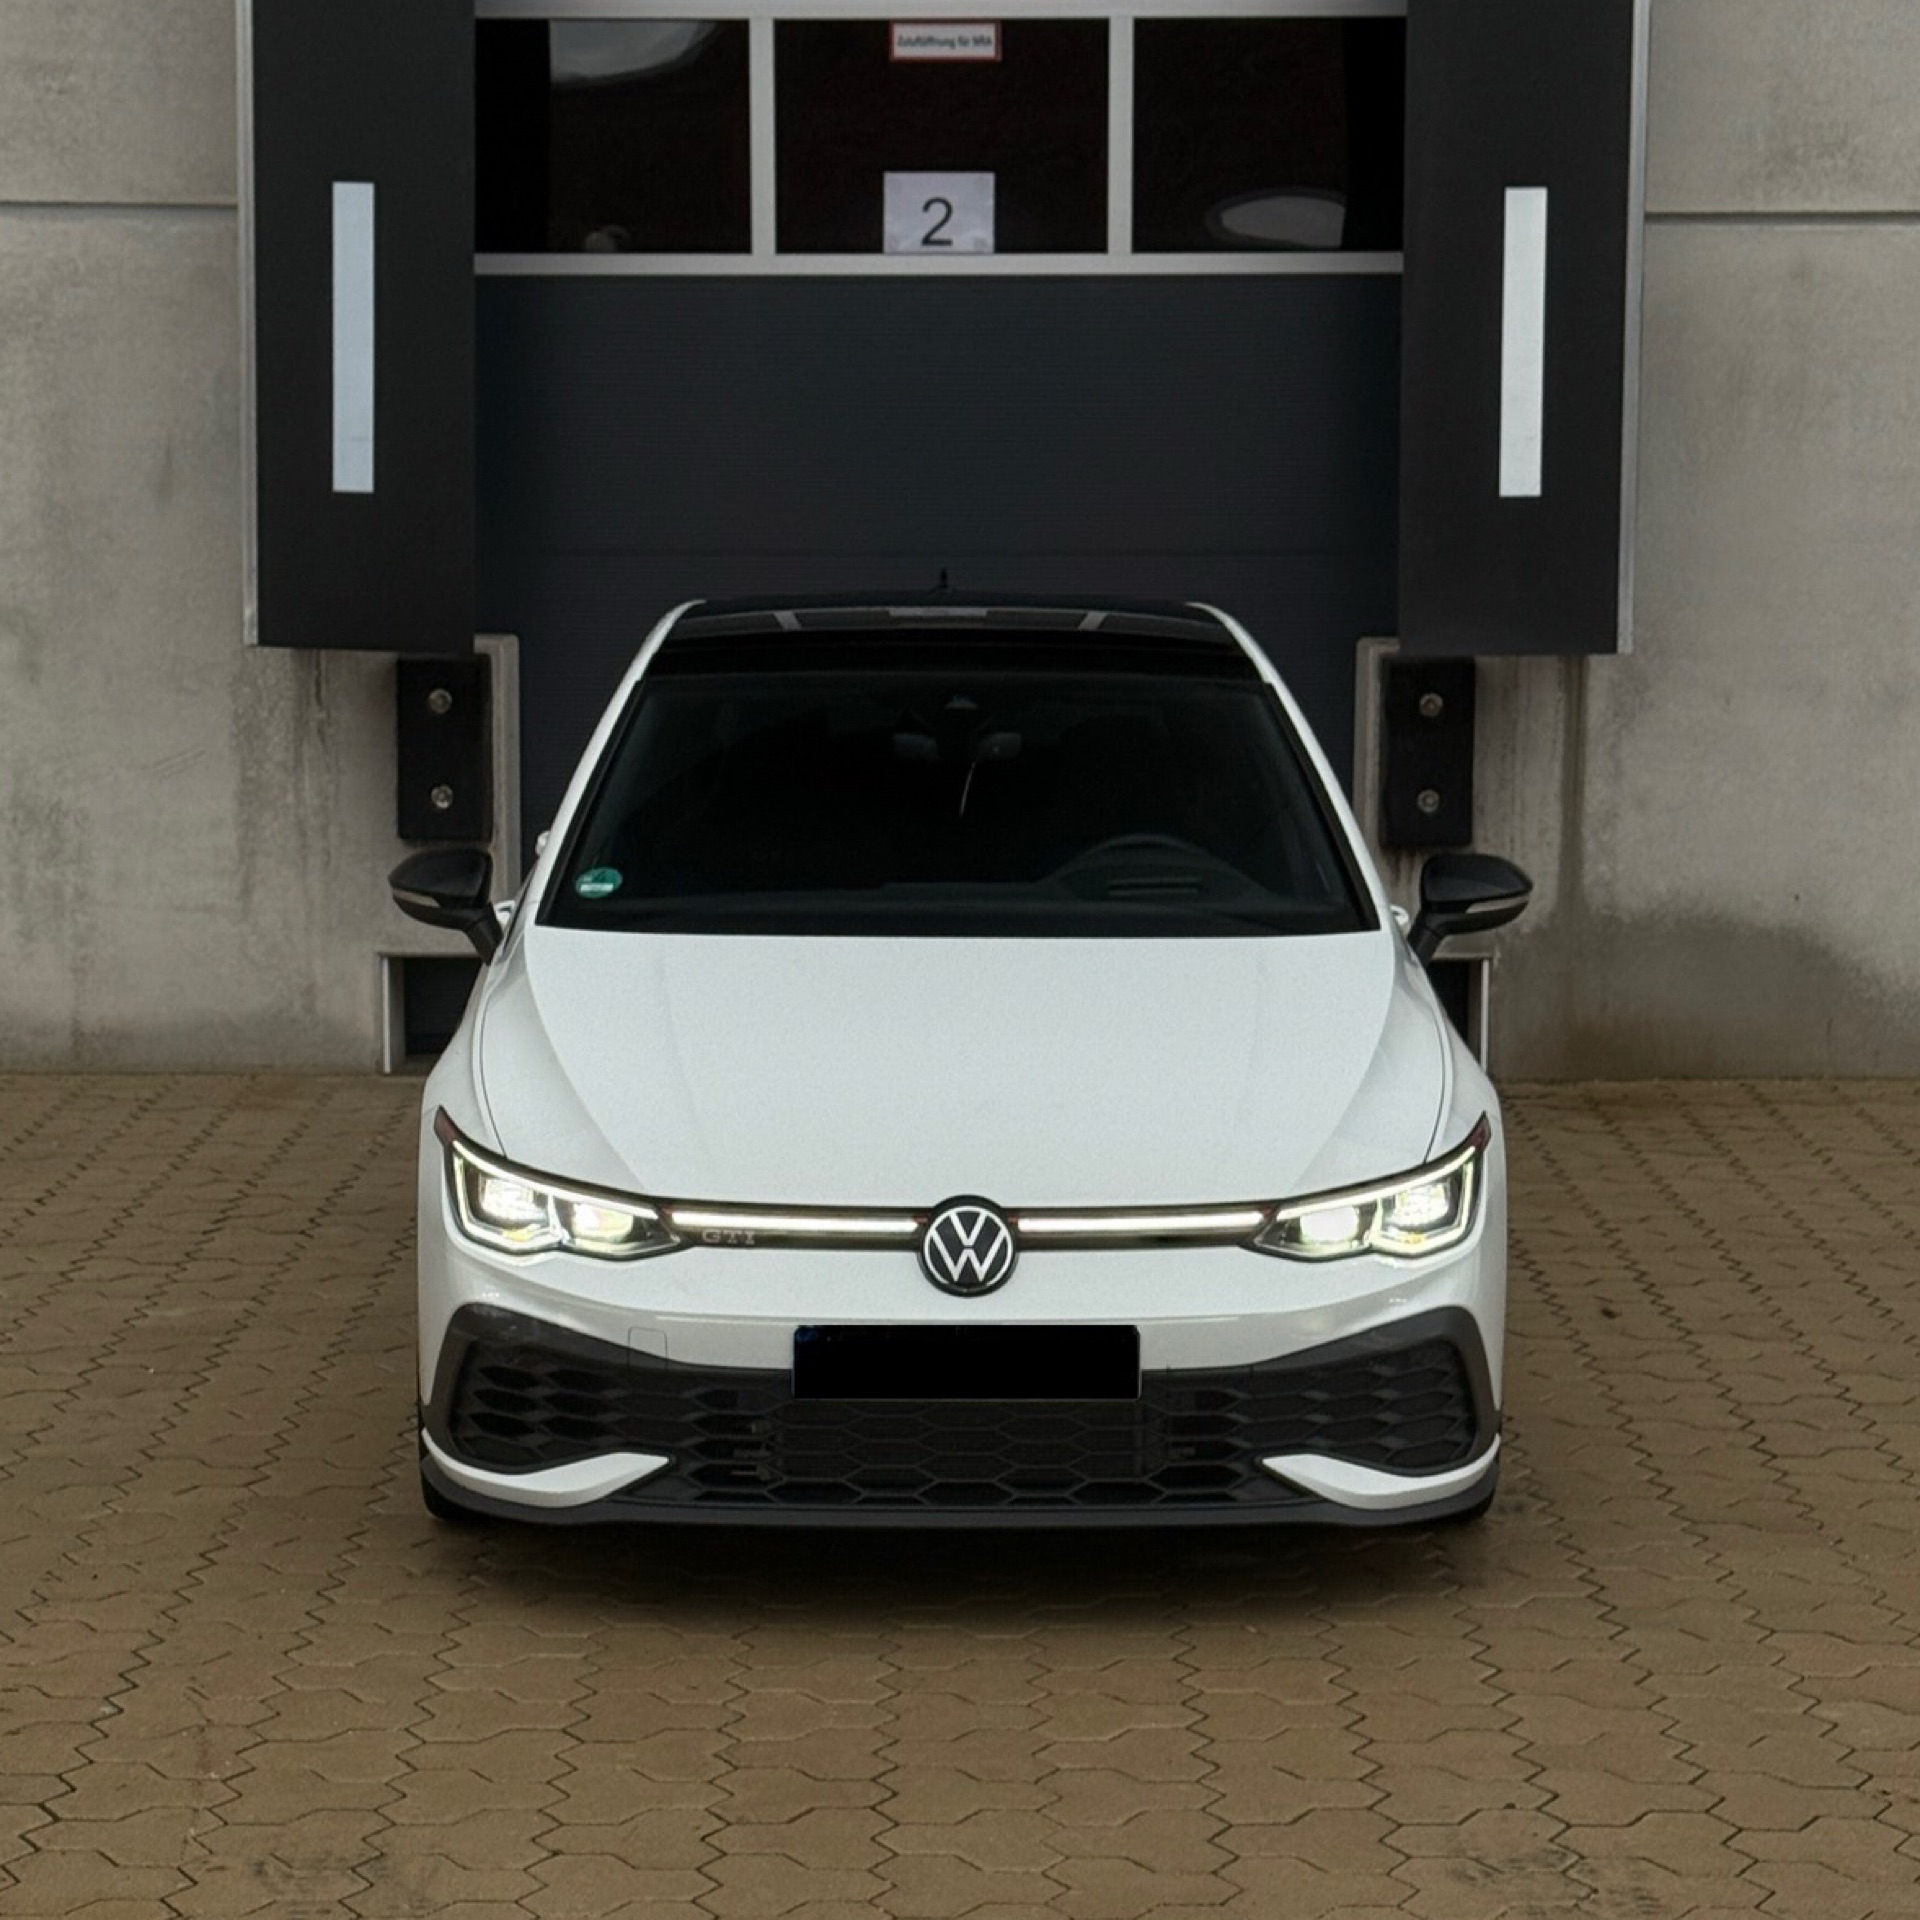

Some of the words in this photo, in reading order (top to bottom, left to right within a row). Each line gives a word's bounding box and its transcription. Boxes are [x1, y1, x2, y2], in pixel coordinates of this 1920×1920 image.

[922, 198, 953, 246] 2
[702, 1228, 755, 1245] GTI
[926, 1207, 1011, 1286] VW
